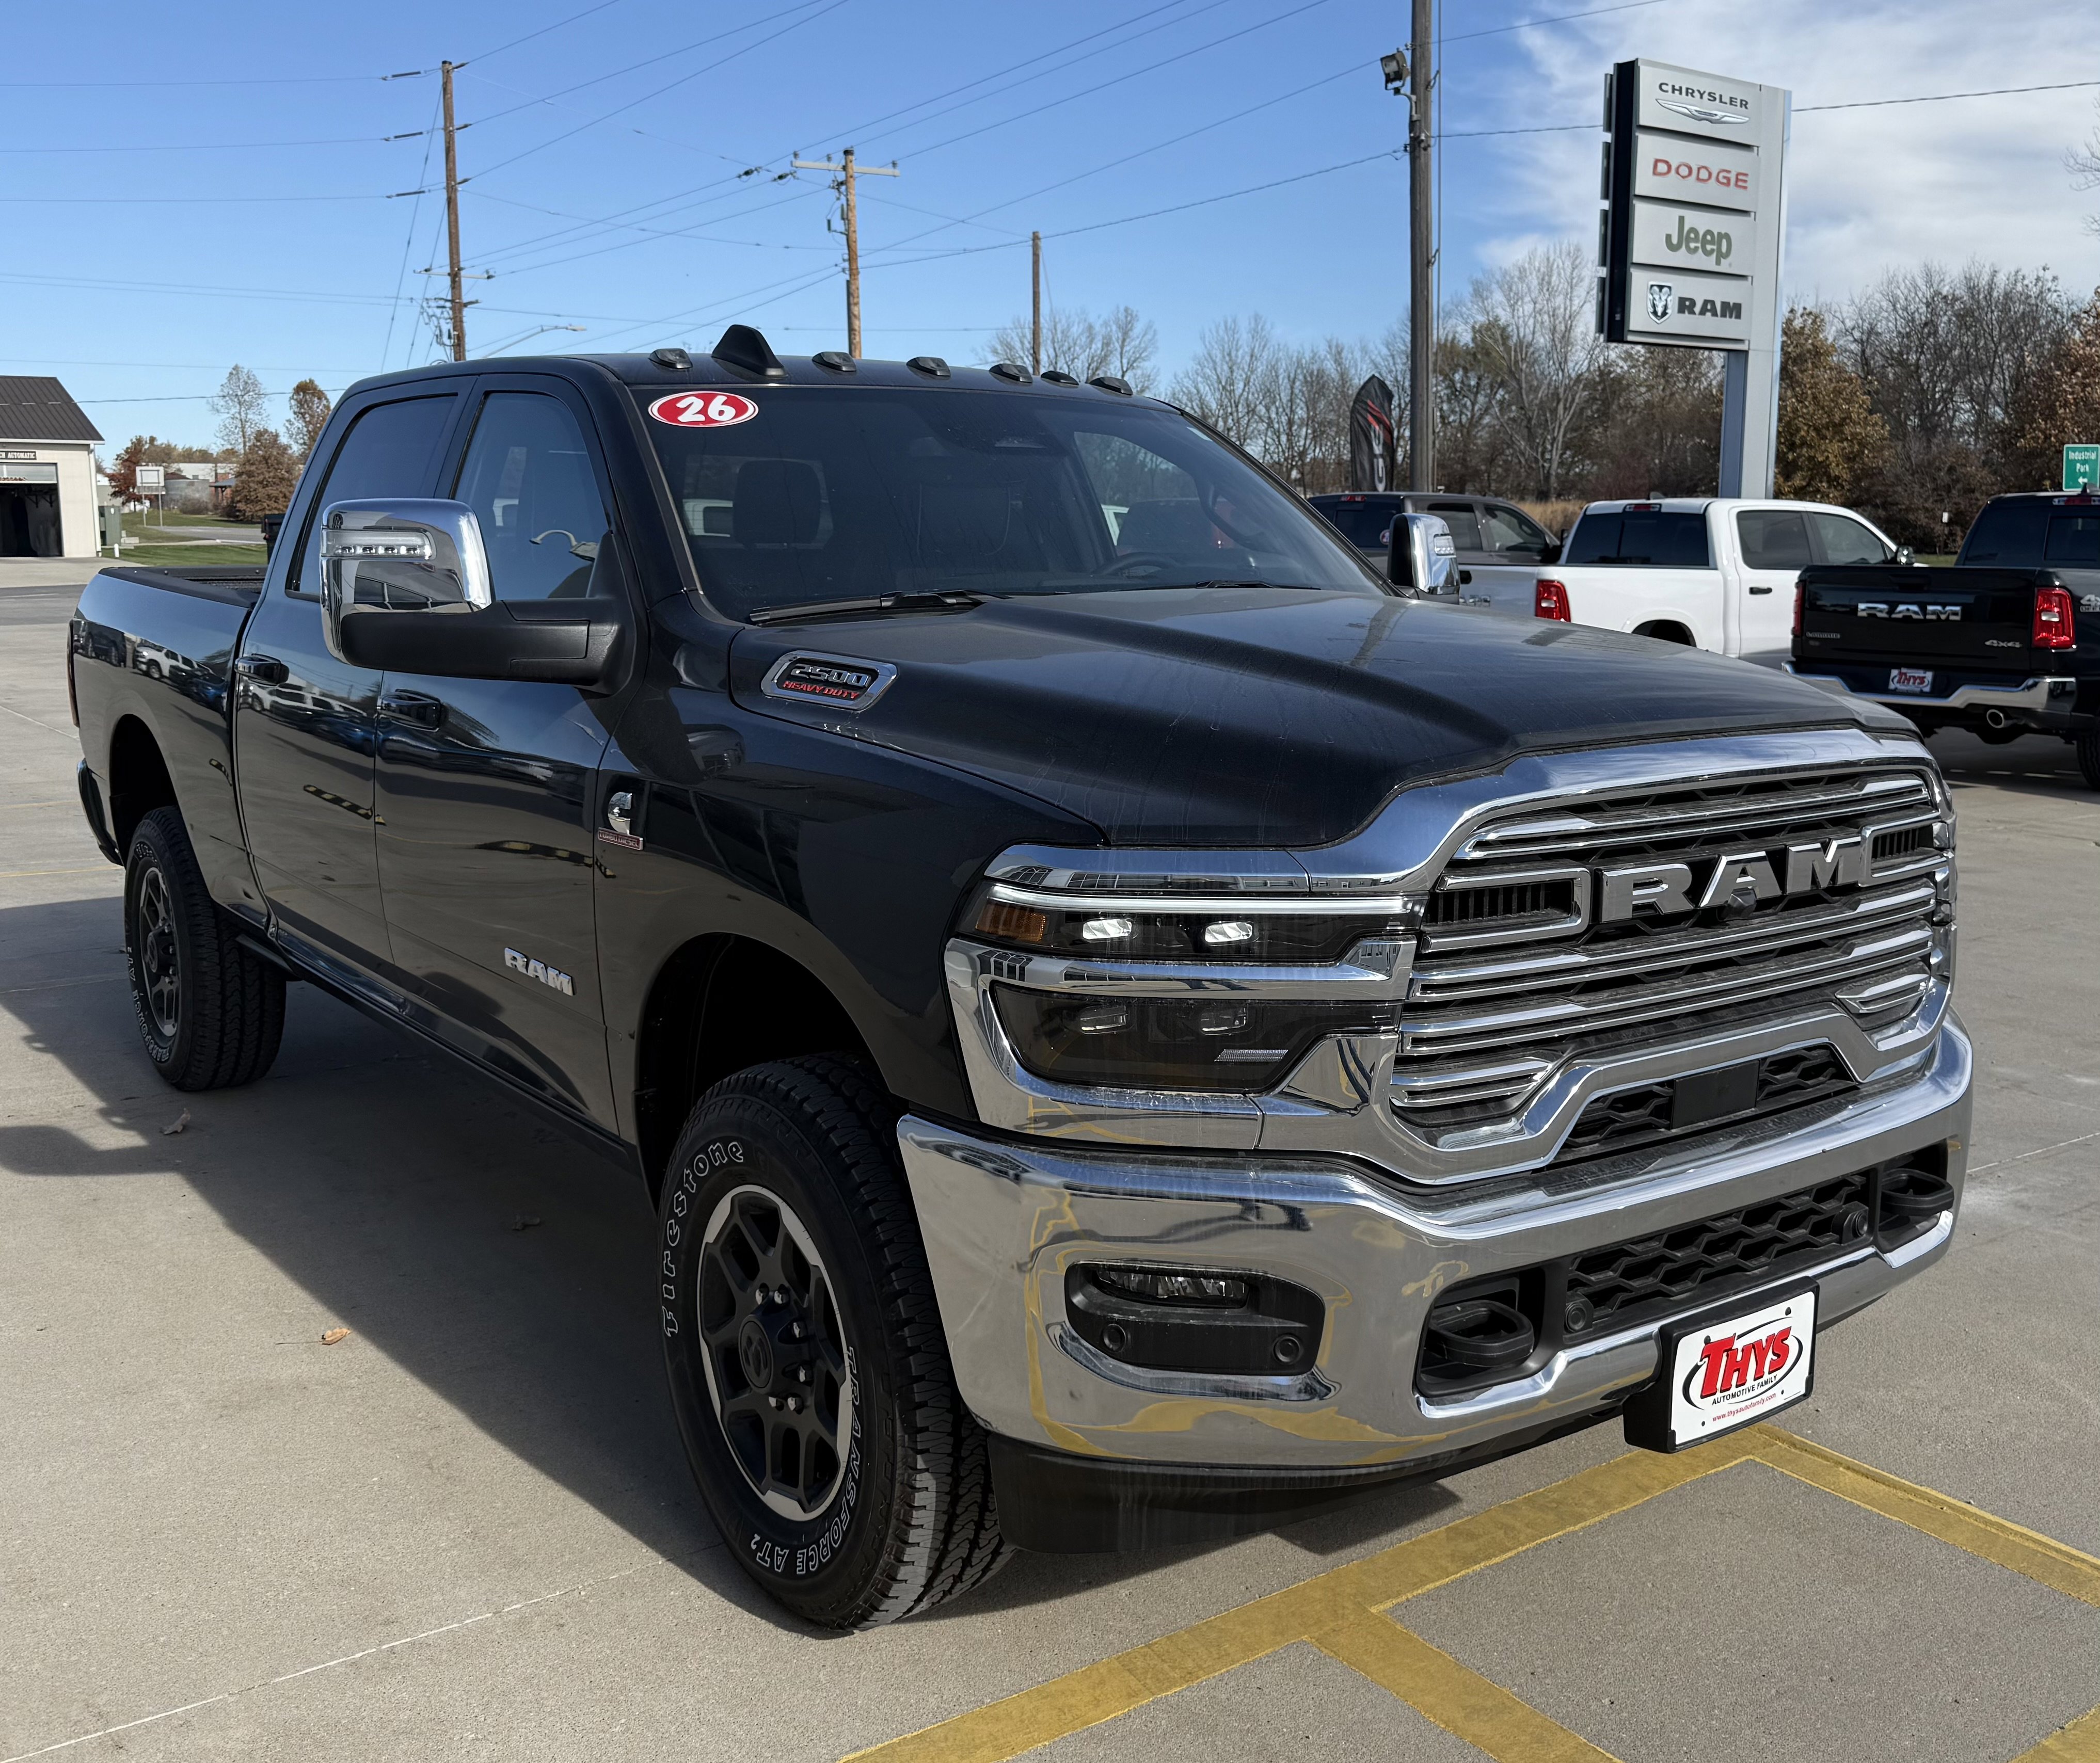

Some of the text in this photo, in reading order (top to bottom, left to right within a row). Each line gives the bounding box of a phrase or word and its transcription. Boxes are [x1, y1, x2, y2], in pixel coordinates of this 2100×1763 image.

[1658, 83, 1748, 110] CHRYSLER
[1652, 158, 1748, 189] DODGE
[1665, 216, 1732, 266] Jeep
[1677, 297, 1742, 319] RAM
[676, 395, 736, 423] 26
[2069, 450, 2096, 460] Industrial
[2076, 463, 2089, 472] Park
[1857, 603, 1961, 620] RAM
[790, 663, 871, 687] 2500
[783, 681, 860, 699] HEAVY DUTY
[1600, 836, 1862, 923] RAM
[504, 948, 574, 996] RAM
[662, 1141, 744, 1338] Firestone
[1699, 1326, 1792, 1399] THYS
[1712, 1374, 1777, 1405] AUTOMOTIVE FAMILY
[797, 1345, 861, 1574] TRANSFORCE
